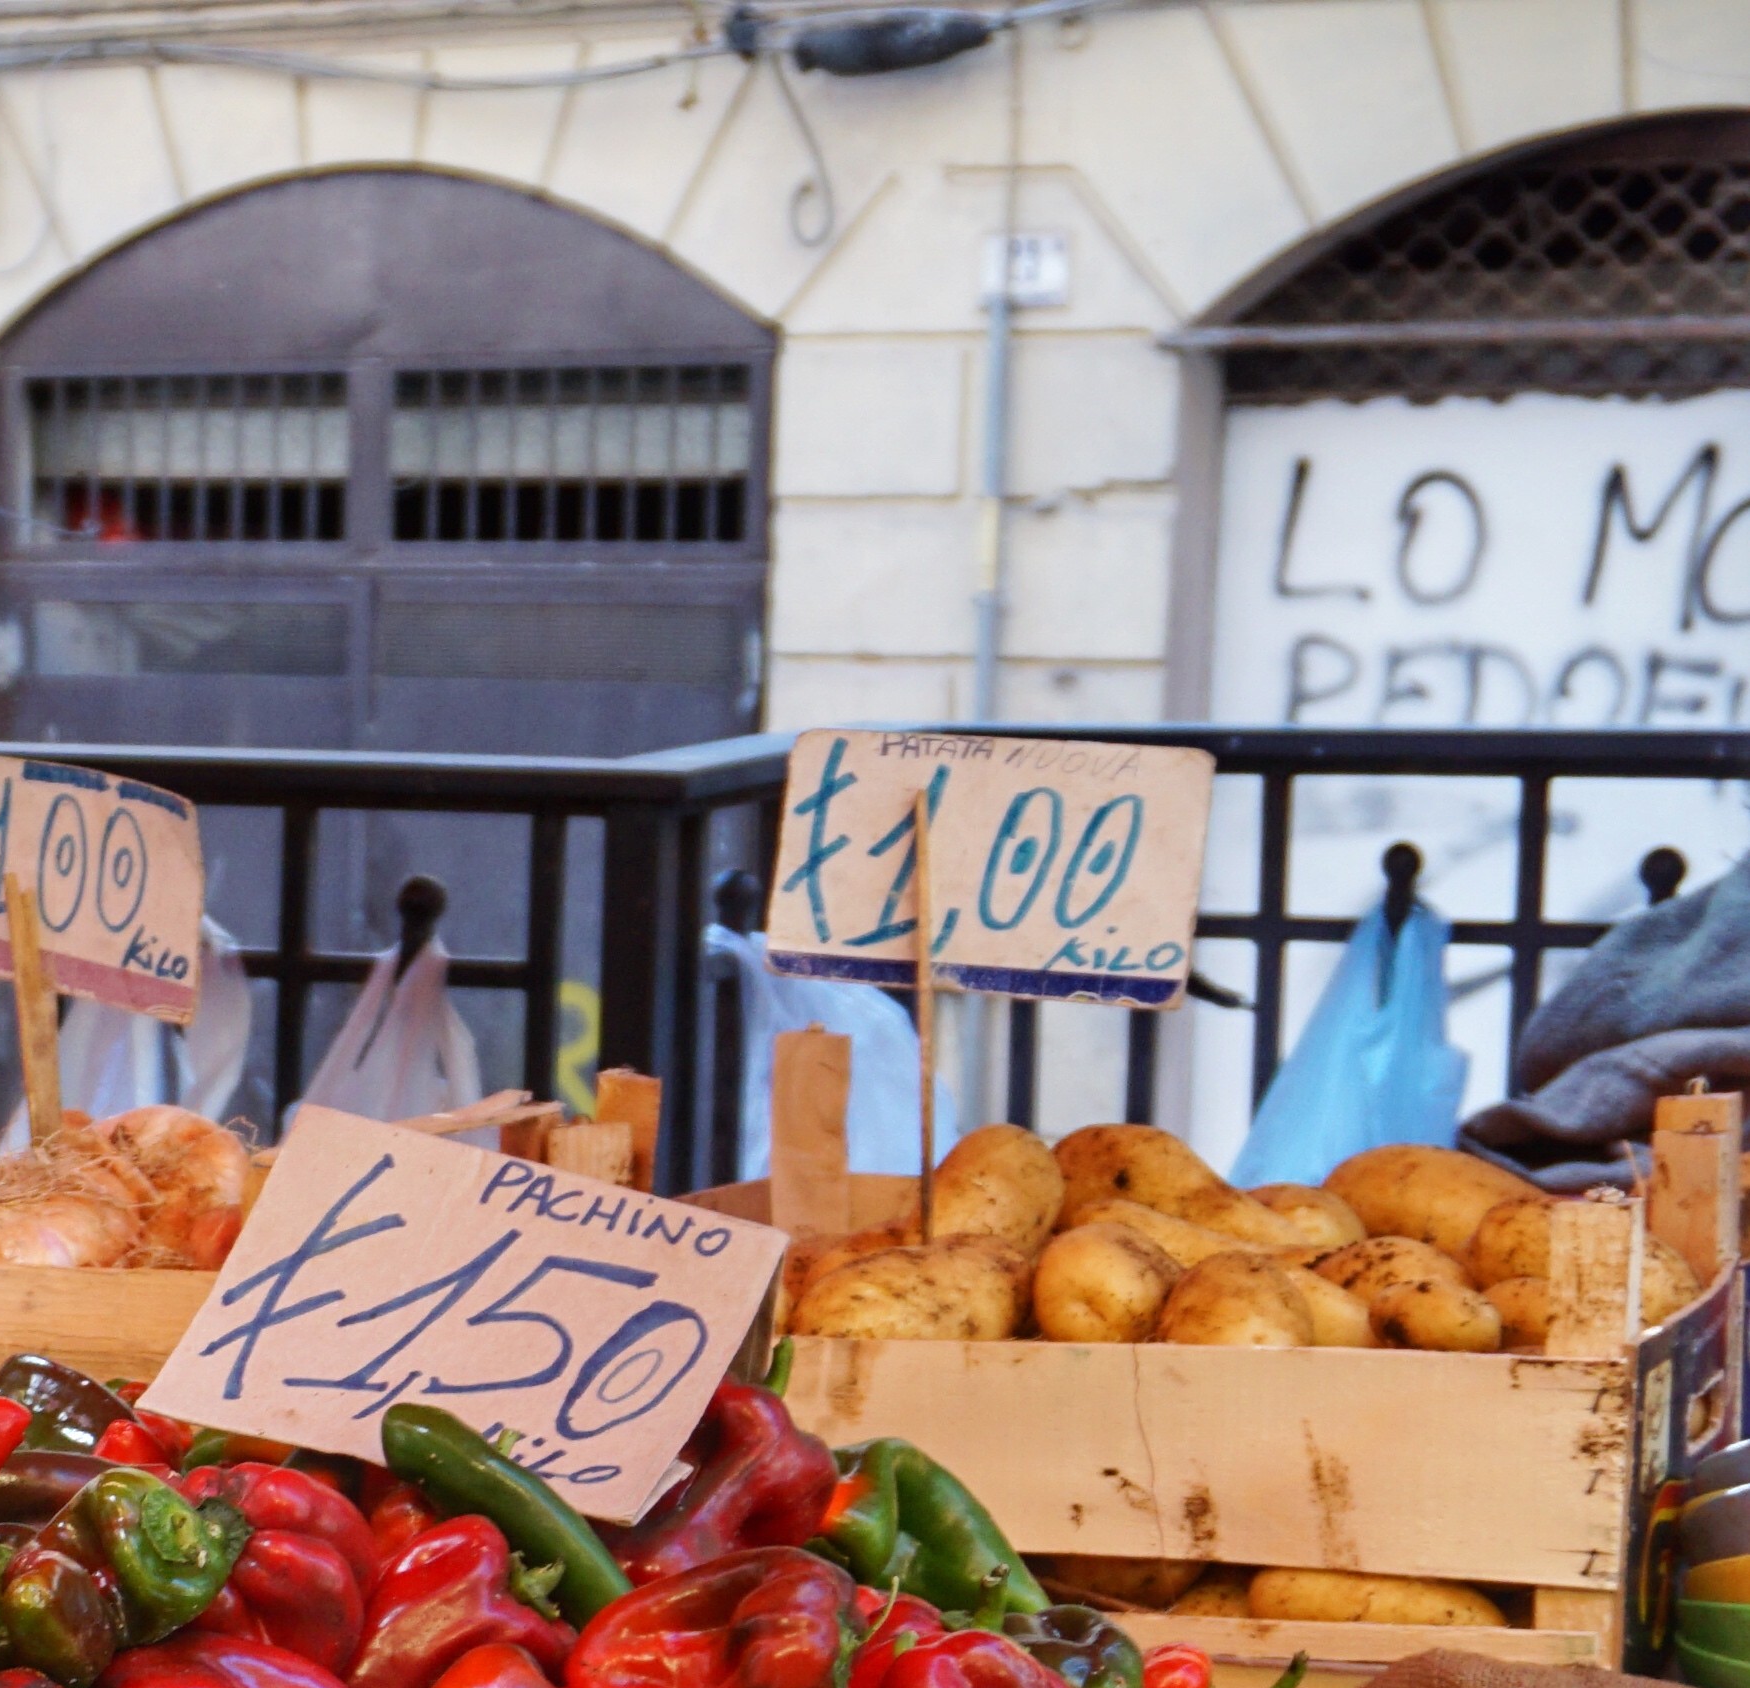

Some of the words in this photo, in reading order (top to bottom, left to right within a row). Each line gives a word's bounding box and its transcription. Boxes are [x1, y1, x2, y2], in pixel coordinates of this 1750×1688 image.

[1273, 455, 1488, 607] LO
[880, 733, 996, 760] PATATA
[1004, 742, 1142, 782] NUOVA
